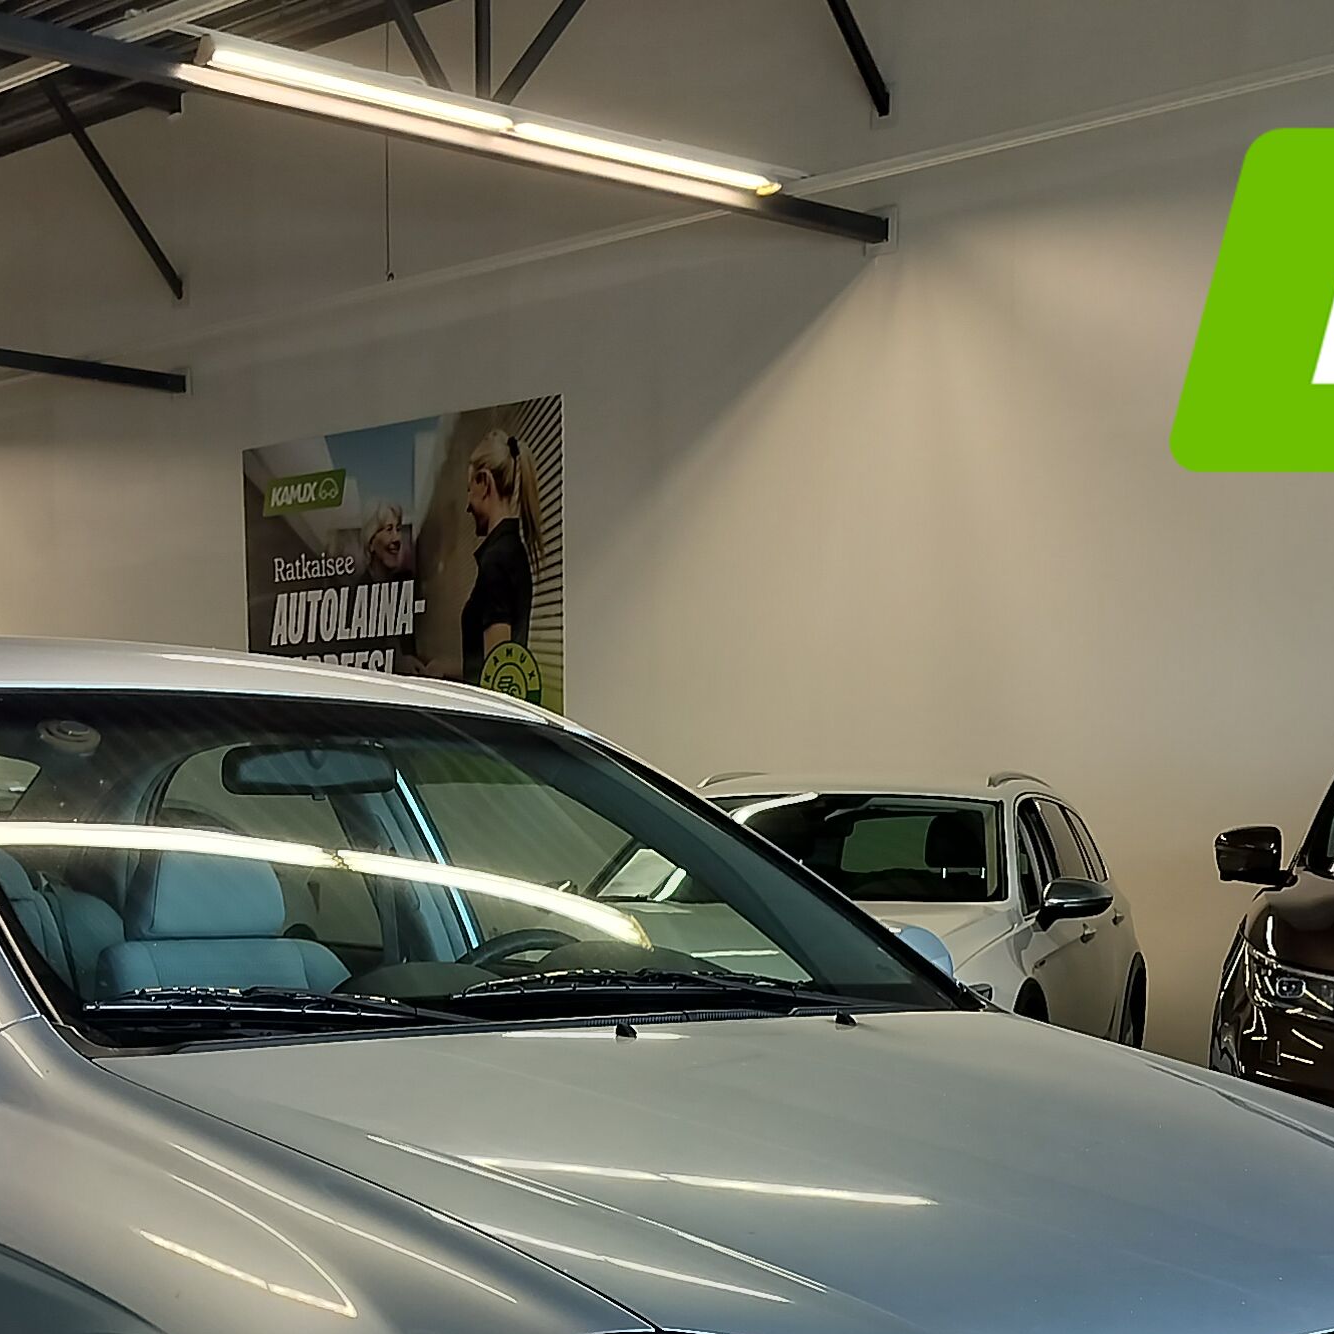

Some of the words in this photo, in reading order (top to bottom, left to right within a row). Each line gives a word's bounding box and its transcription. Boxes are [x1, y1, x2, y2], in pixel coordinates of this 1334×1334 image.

[270, 481, 318, 508] KAMUX
[273, 552, 355, 583] Ratkaisee
[270, 579, 426, 646] AUTOLAINA-
